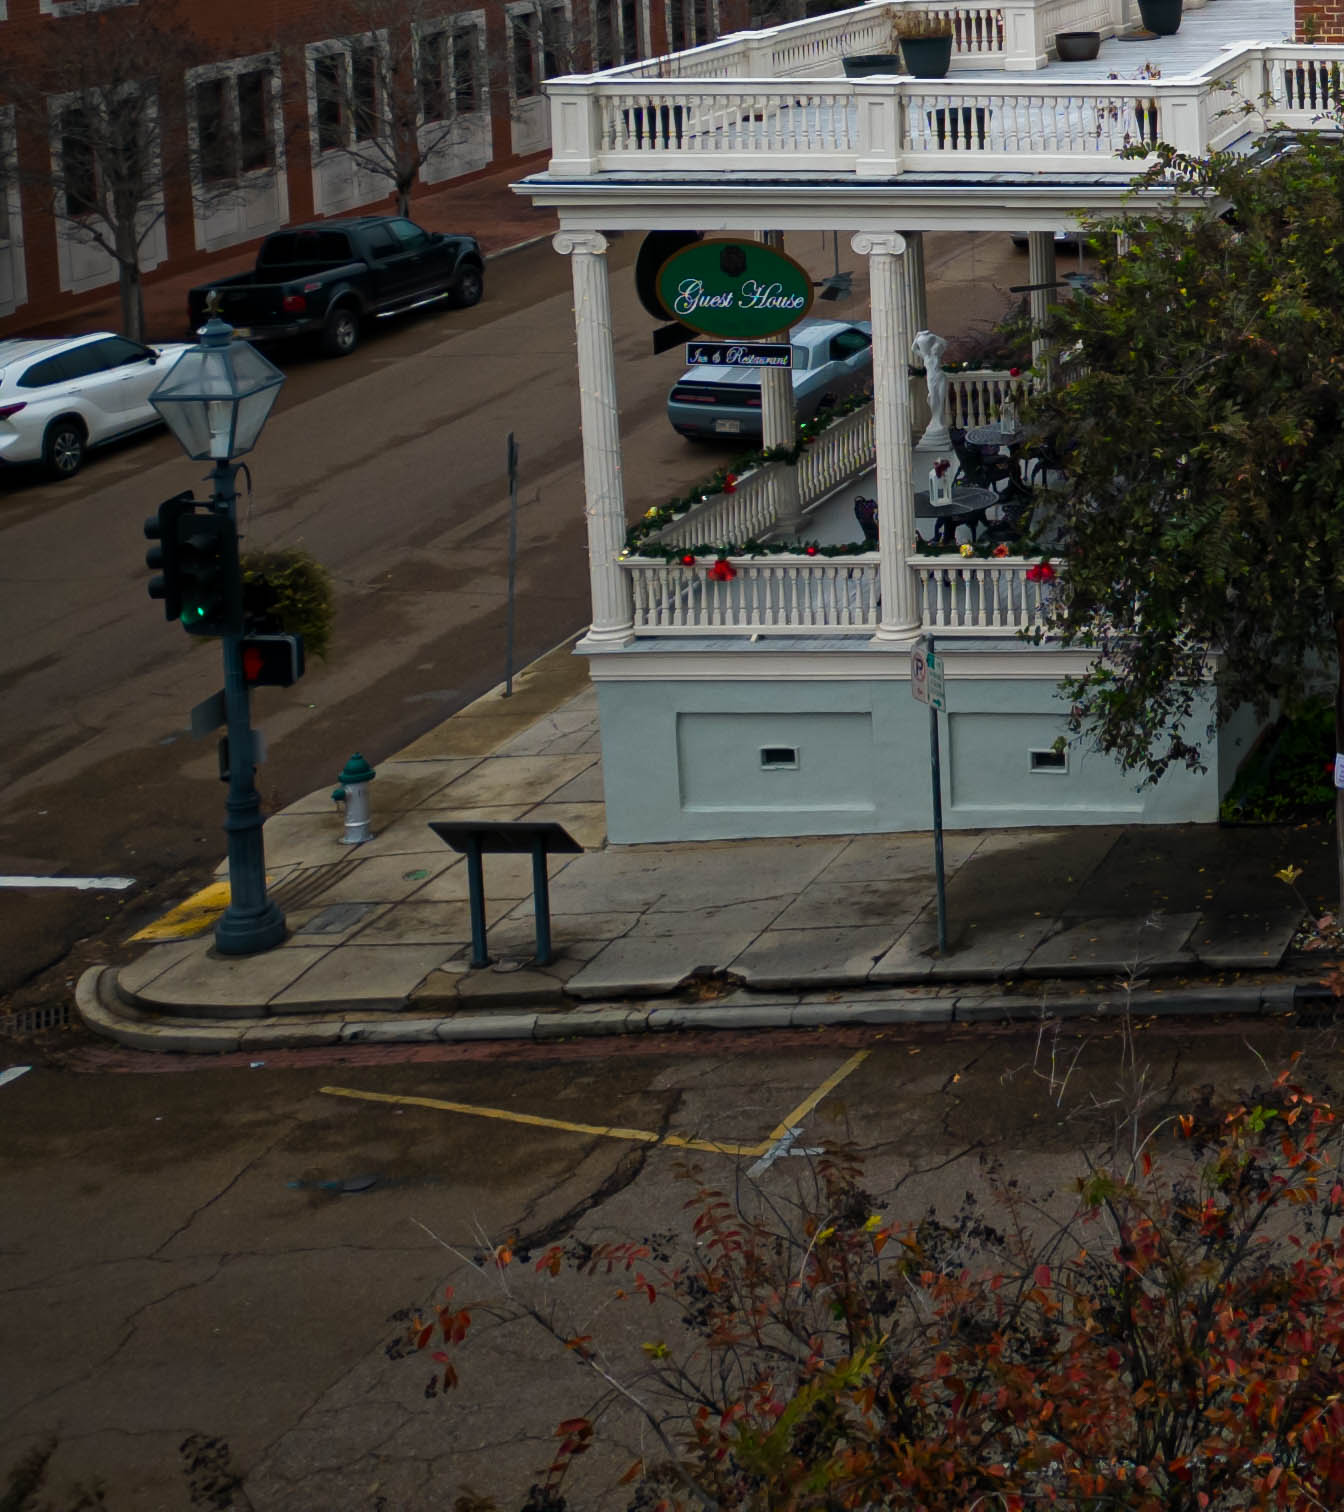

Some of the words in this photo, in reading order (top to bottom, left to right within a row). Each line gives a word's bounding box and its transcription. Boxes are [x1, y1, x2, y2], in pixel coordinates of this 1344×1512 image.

[674, 278, 733, 315] Guest
[738, 279, 805, 309] House
[725, 346, 789, 366] Restaurant
